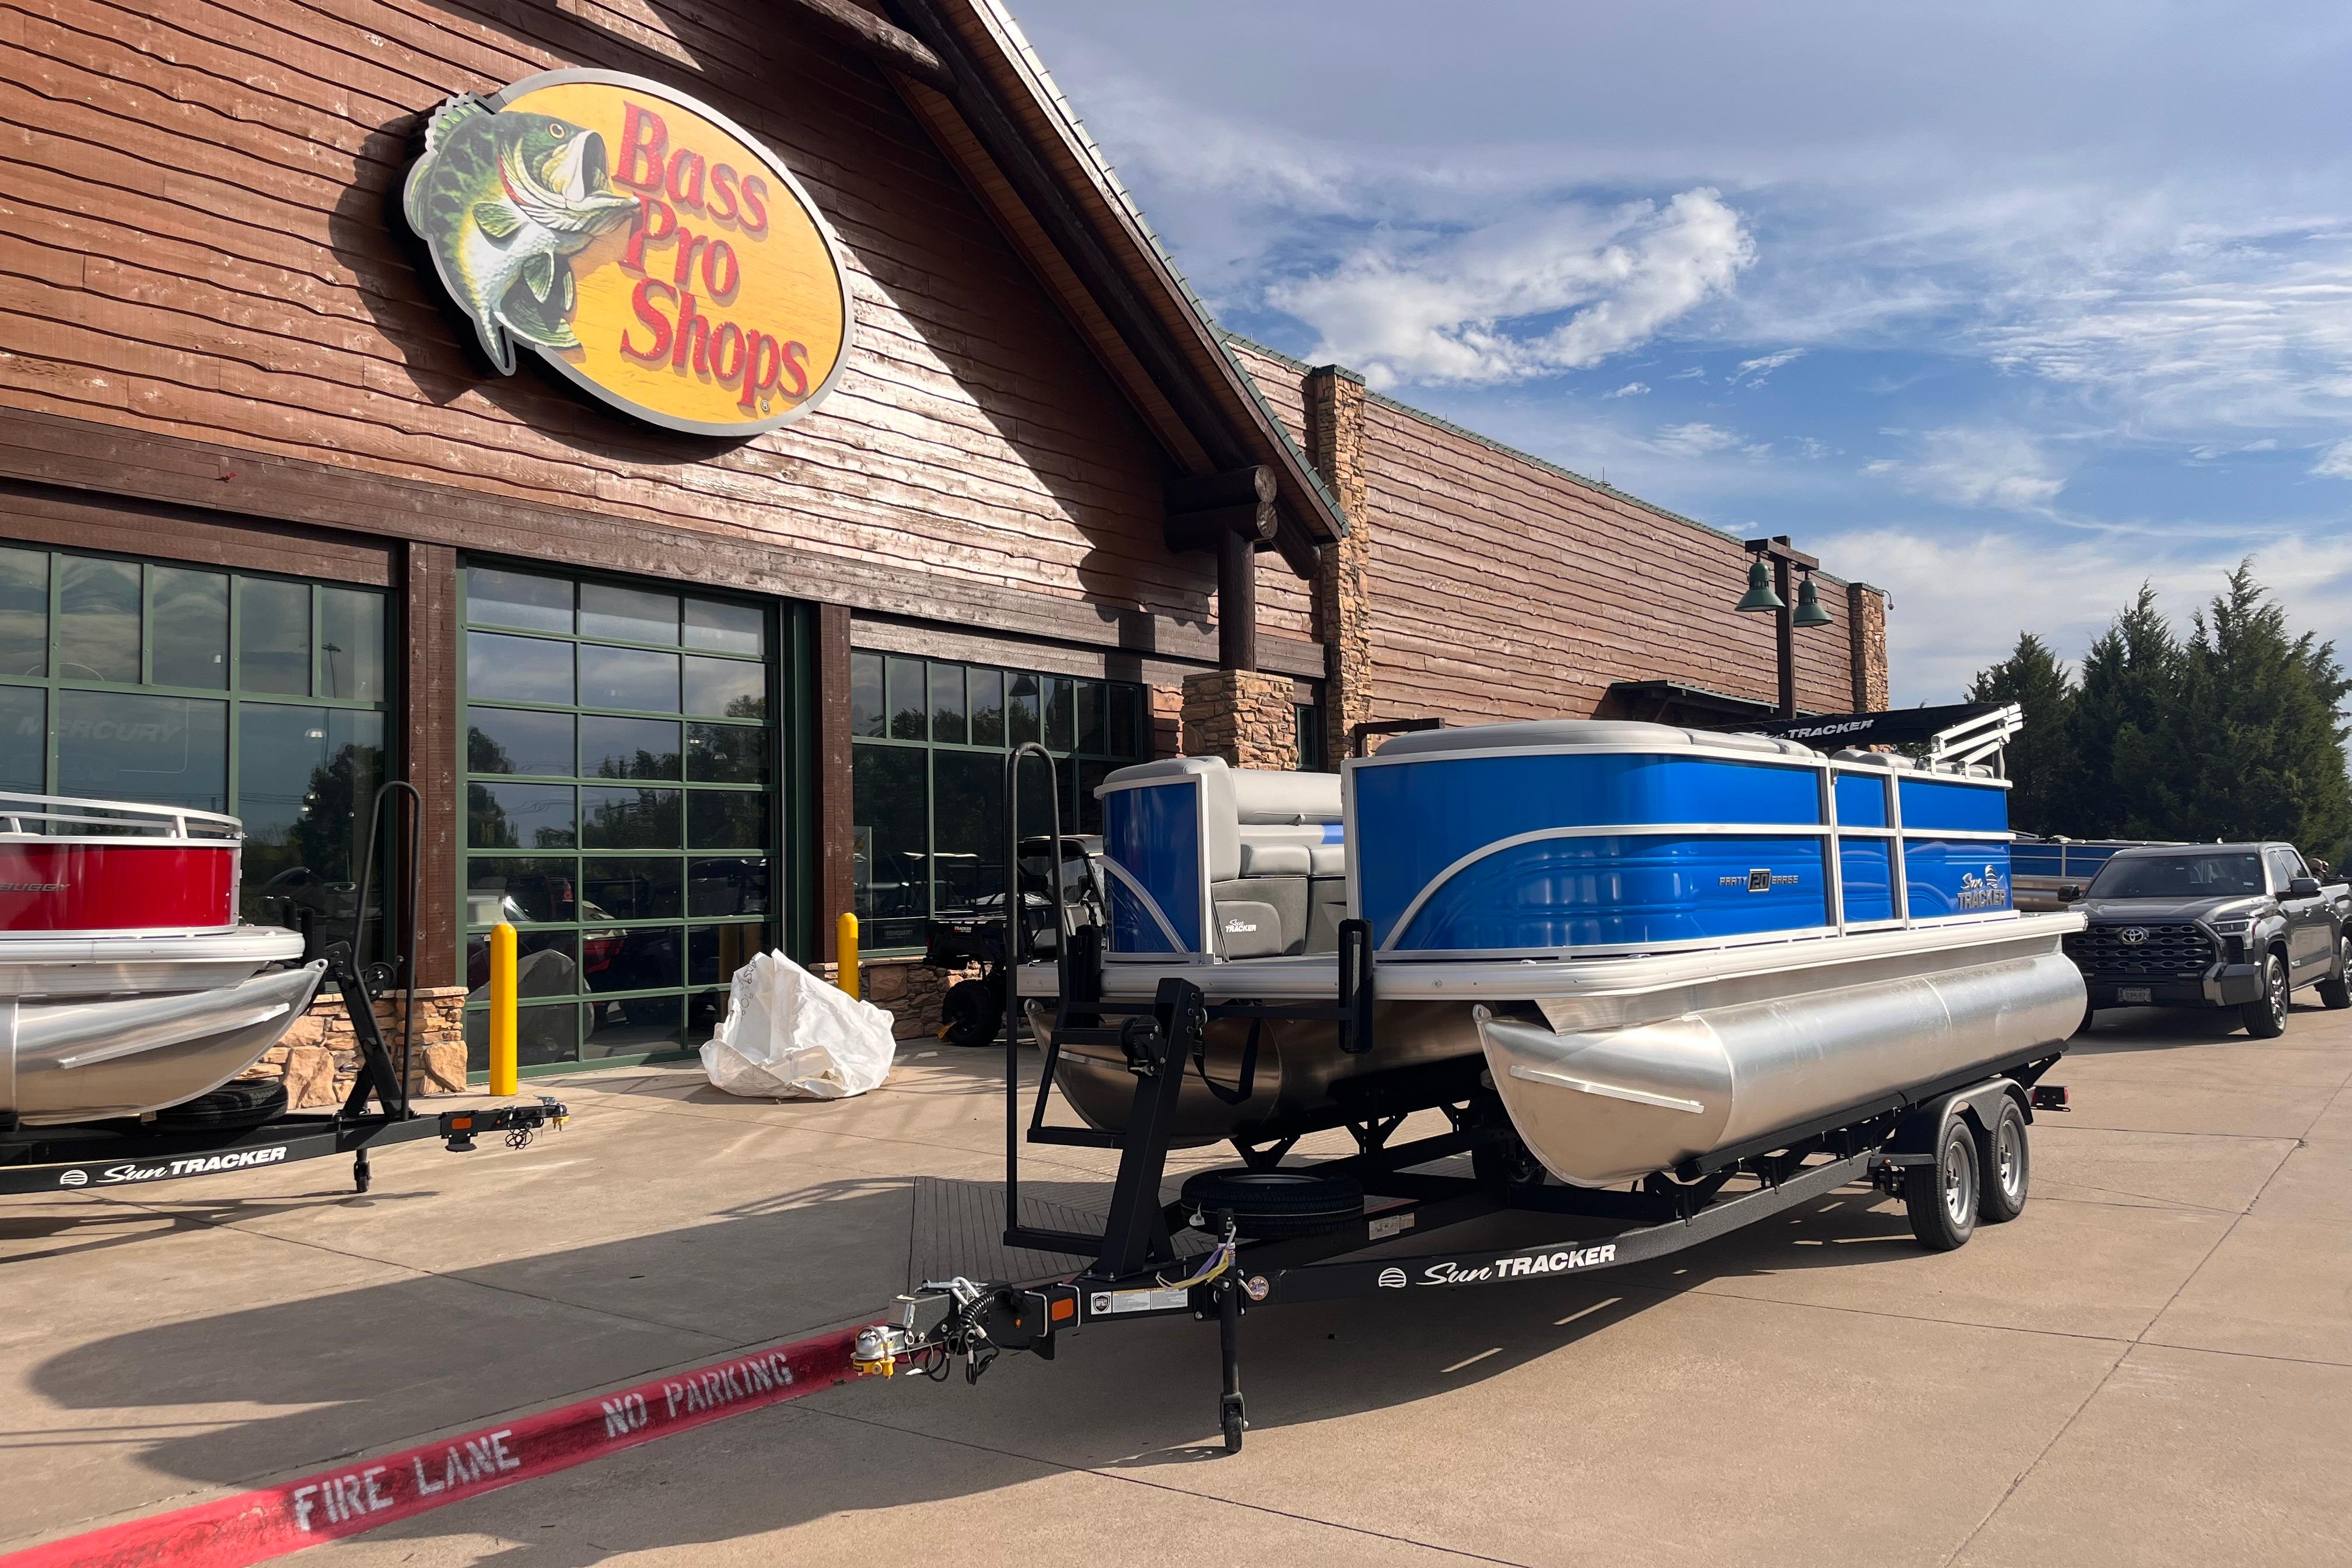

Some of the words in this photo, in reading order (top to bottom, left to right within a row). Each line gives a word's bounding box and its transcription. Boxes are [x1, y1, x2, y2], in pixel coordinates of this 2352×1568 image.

[611, 100, 770, 233] Bass
[617, 191, 739, 297] Pro
[620, 278, 810, 408] Shops
[1787, 719, 1874, 739] TRACKER
[1717, 876, 1747, 887] PARTY
[1752, 874, 1769, 888] 20
[1957, 888, 2006, 910] TRACKER
[1960, 872, 1983, 890] Sun
[1225, 925, 1256, 933] TRACKER
[96, 1164, 168, 1183] Sun
[170, 1146, 287, 1176] TRACKER
[1415, 1262, 1493, 1285] Sun
[1494, 1244, 1616, 1278] TRACKER
[293, 1465, 394, 1532] FIRE
[413, 1429, 521, 1497] LANE
[601, 1393, 648, 1438] NO
[663, 1353, 794, 1418] PARKING
